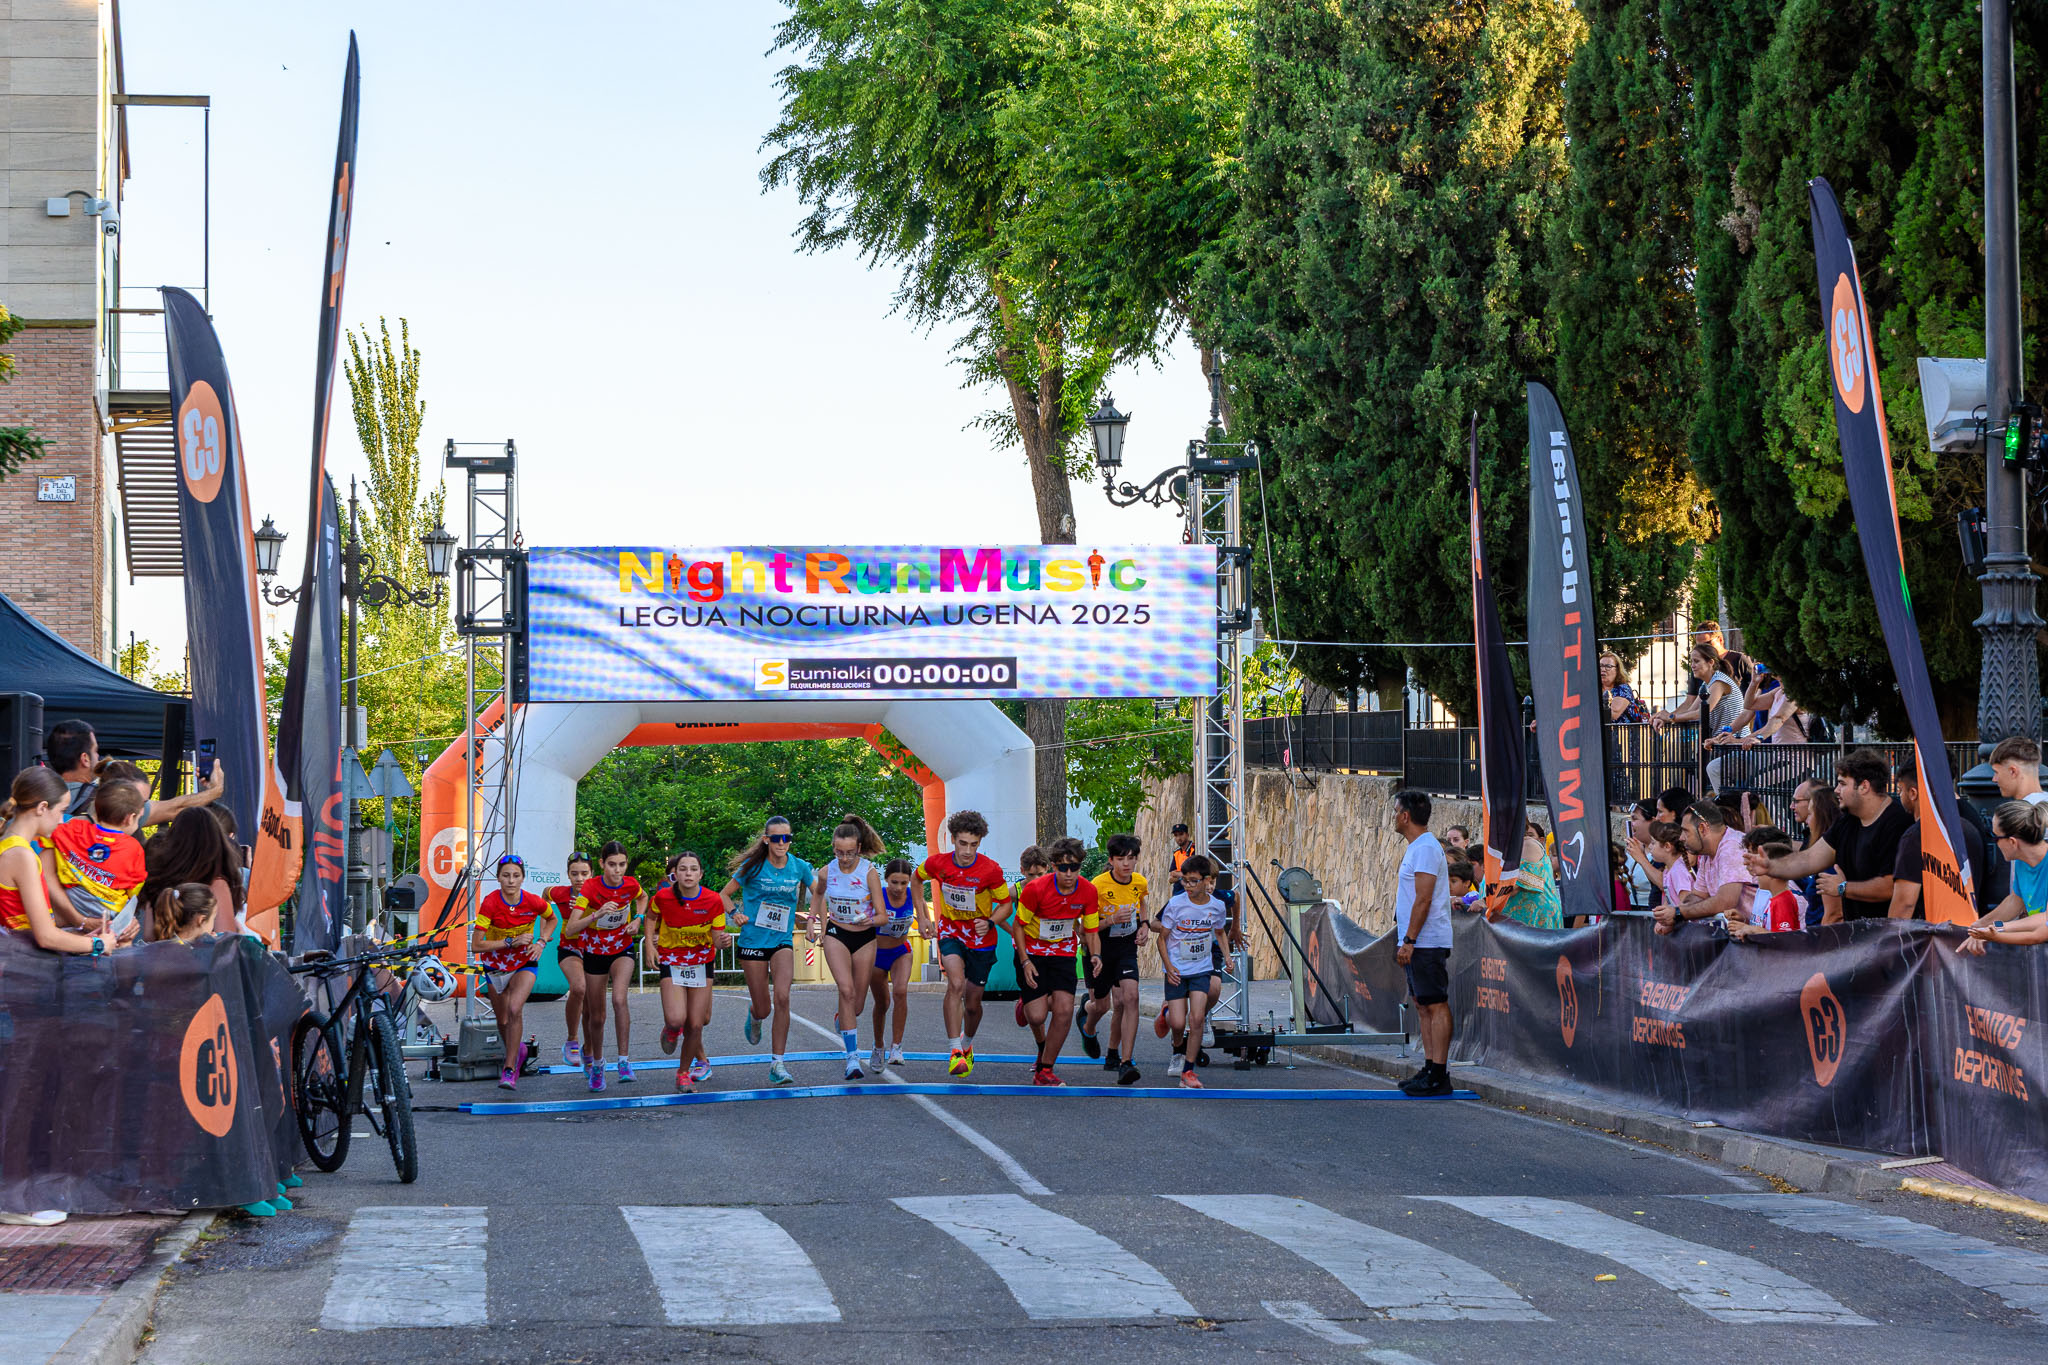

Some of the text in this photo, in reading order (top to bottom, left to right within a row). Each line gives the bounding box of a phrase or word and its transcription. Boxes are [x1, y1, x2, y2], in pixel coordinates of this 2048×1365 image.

[619, 604, 1151, 627] LEGUA NOCTURNA UGENA 2025
[790, 664, 1010, 684] sumialki 00:00:00
[790, 682, 831, 690] ALQUILAMOS
[531, 875, 561, 884] TOLEDO
[951, 893, 966, 903] 496
[767, 911, 782, 922] 484
[837, 905, 852, 915] 481
[1050, 924, 1065, 932] 497
[741, 948, 765, 957] NIKE
[1190, 944, 1205, 953] 486
[680, 970, 696, 979] 495
[1561, 974, 1576, 1030] e3
[1640, 980, 1690, 1012] EVENTOS
[1633, 1016, 1686, 1049] DEPORTIVOS
[1809, 995, 1841, 1063] e3
[1964, 1004, 2027, 1050] EVENTOS
[196, 1023, 232, 1108] e3
[1954, 1047, 2029, 1102] DEPORTIVOS
